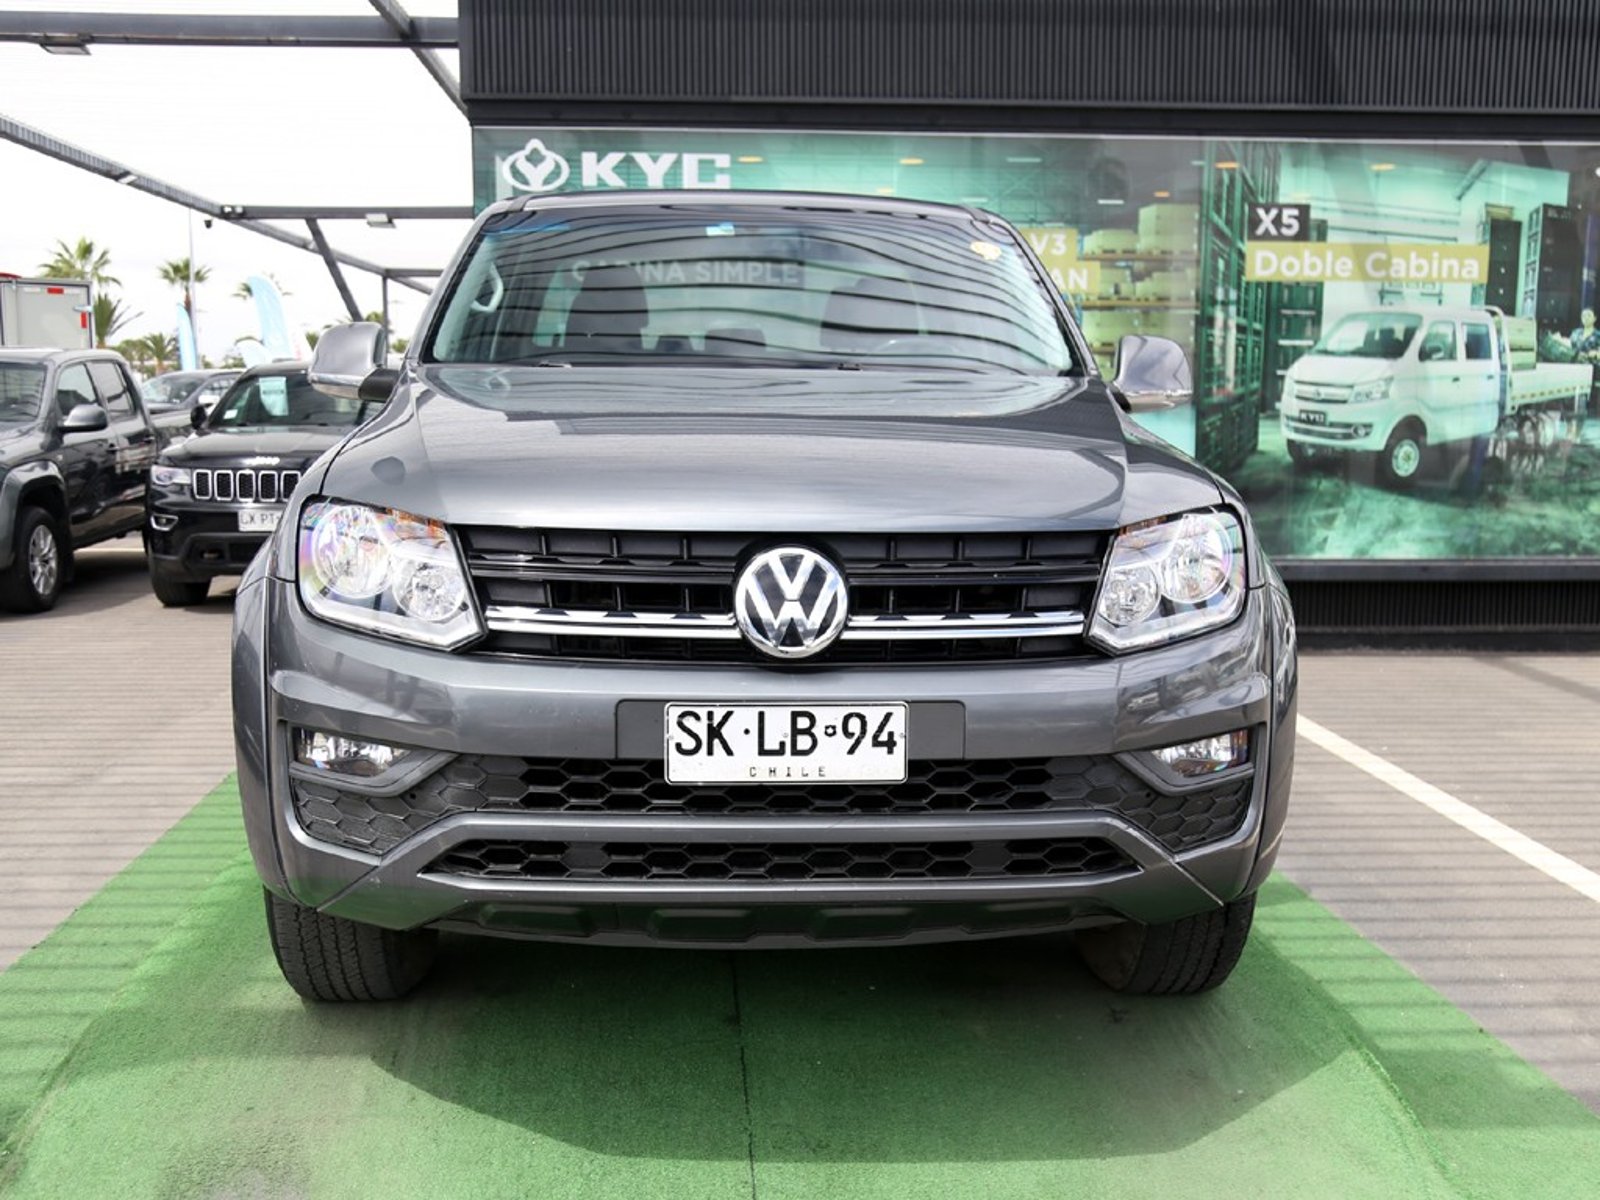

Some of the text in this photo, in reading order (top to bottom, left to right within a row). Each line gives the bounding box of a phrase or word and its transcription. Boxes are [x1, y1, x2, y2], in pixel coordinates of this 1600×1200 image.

[580, 151, 731, 189] KYC
[1255, 207, 1300, 237] X5
[1030, 233, 1067, 256] V3
[697, 261, 799, 284] SIMPLE
[1254, 249, 1480, 279] Doble Cabina
[1051, 267, 1089, 291] AN
[749, 766, 827, 778] CHILE
